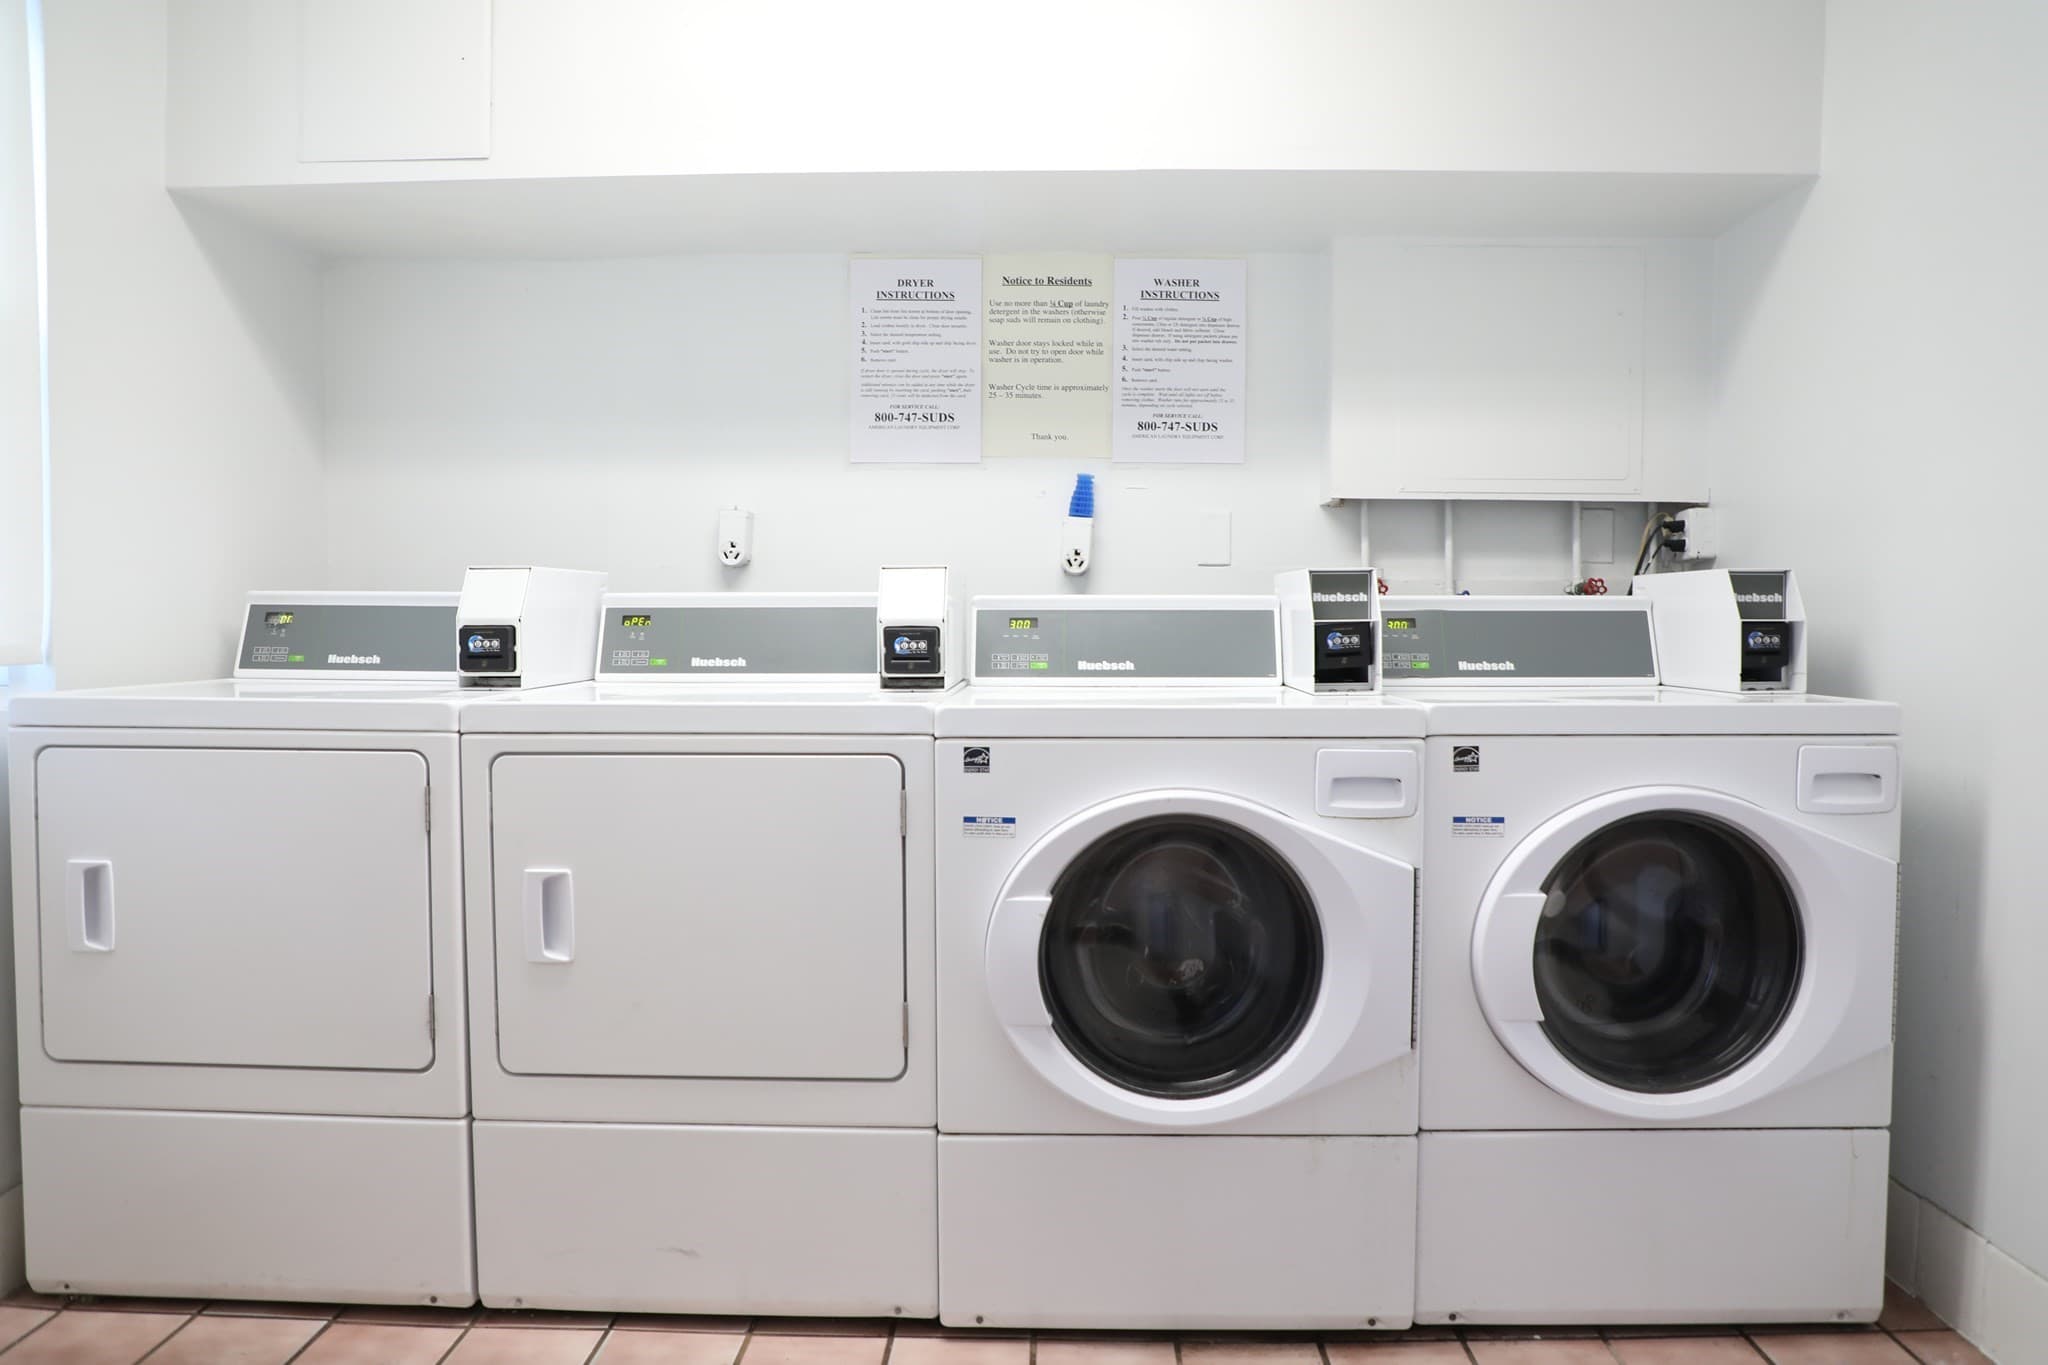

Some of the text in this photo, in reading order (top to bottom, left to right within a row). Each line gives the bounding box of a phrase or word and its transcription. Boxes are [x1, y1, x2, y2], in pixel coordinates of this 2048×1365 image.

[897, 279, 935, 287] DRYER
[1002, 276, 1092, 287] Notice to Residents
[1153, 278, 1200, 288] WASHER
[876, 290, 956, 299] INSTRUCTIONS
[1140, 290, 1220, 300] INSTRUCTIONS
[989, 299, 1002, 307] Use
[1058, 300, 1073, 309] Cup
[1084, 300, 1109, 309] laundry
[988, 308, 1020, 316] detergent
[1033, 340, 1050, 348] stays
[988, 383, 1014, 391] Washer
[1015, 384, 1035, 392] Cycle
[1060, 384, 1109, 392] approximately
[874, 412, 955, 422] 800-747-SUDS
[1137, 421, 1218, 431] 800-747-SUDS
[1031, 433, 1052, 441] Thank
[1312, 592, 1368, 602] Huebsch
[1734, 592, 1783, 602] uebsch
[1009, 620, 1031, 629] 300
[327, 653, 381, 665] Huebsch
[691, 657, 747, 667] Huebsch
[1077, 660, 1136, 670] Huebsch
[1458, 660, 1515, 670] Huebsch
